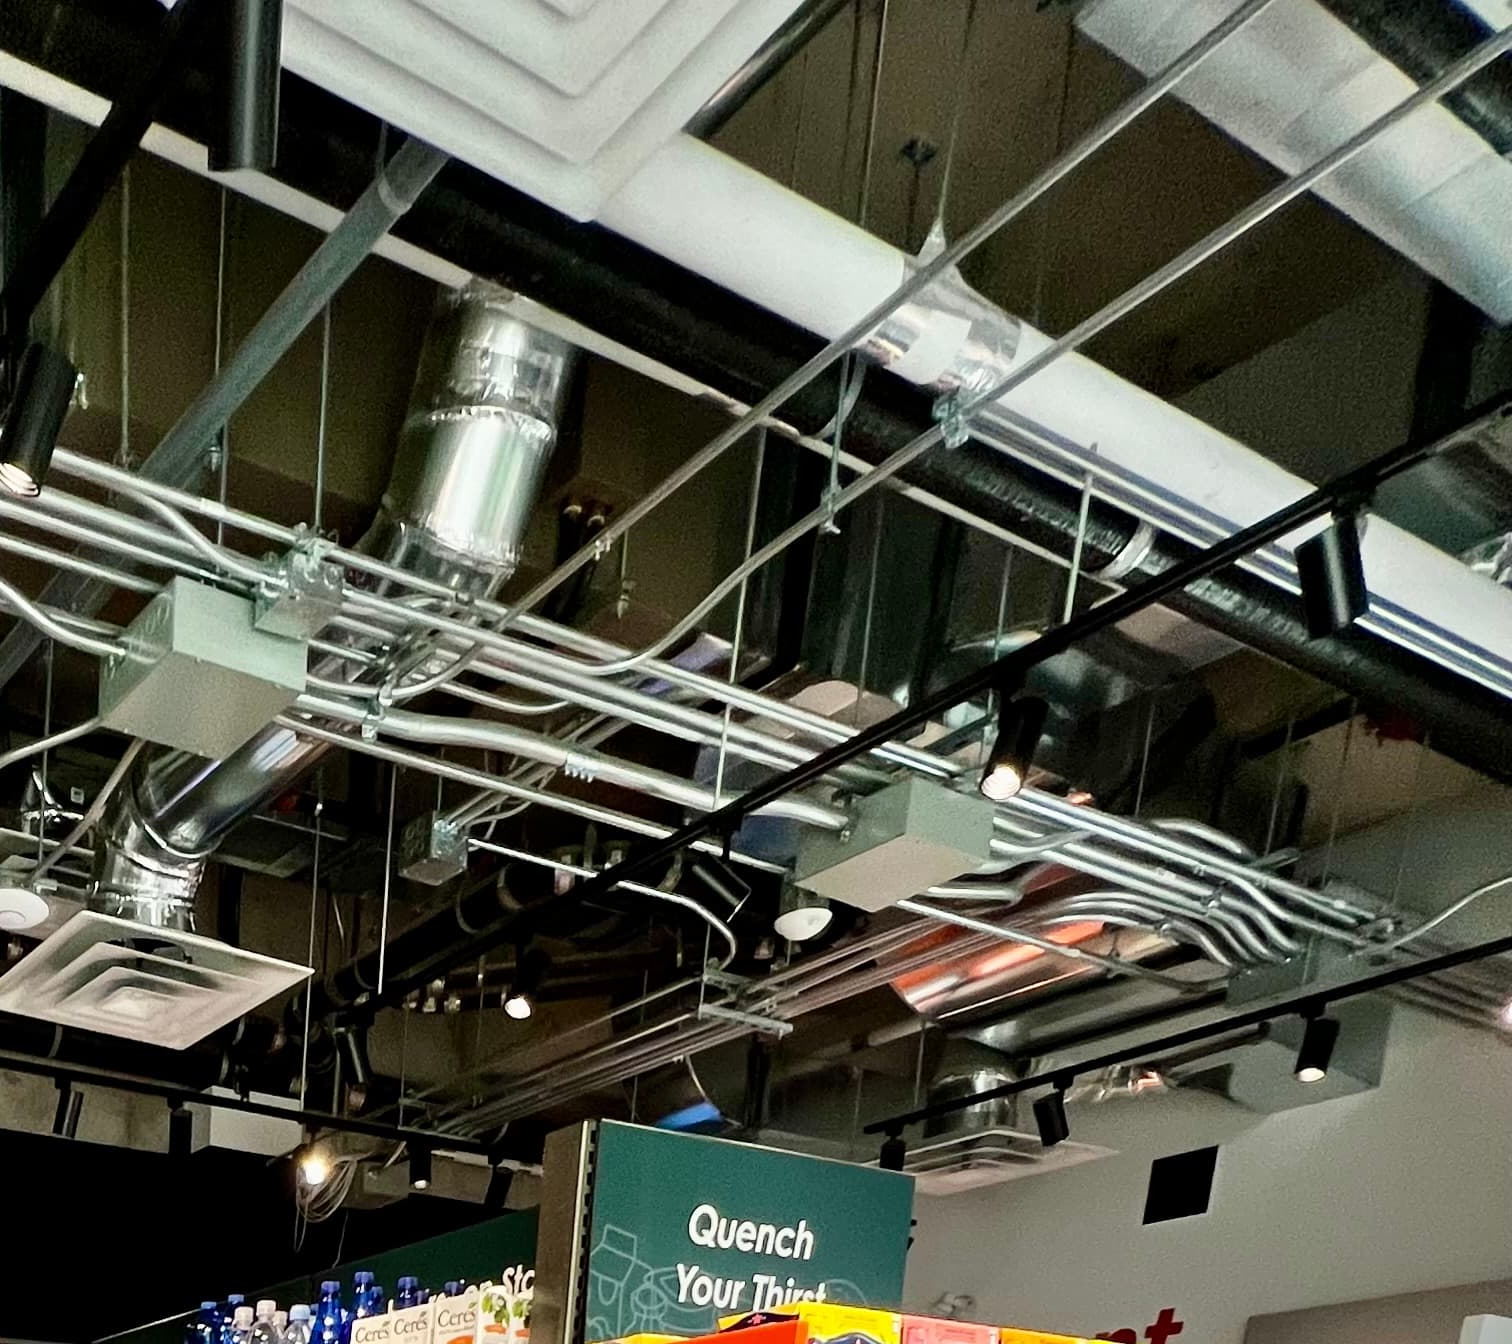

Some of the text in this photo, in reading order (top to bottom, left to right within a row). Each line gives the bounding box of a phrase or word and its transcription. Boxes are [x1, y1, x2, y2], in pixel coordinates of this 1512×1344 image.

[687, 1203, 814, 1261] Quench
[676, 1264, 745, 1311] Your
[394, 1314, 429, 1335] Ceres
[438, 1307, 476, 1329] Ceres
[355, 1325, 390, 1344] Ceres
